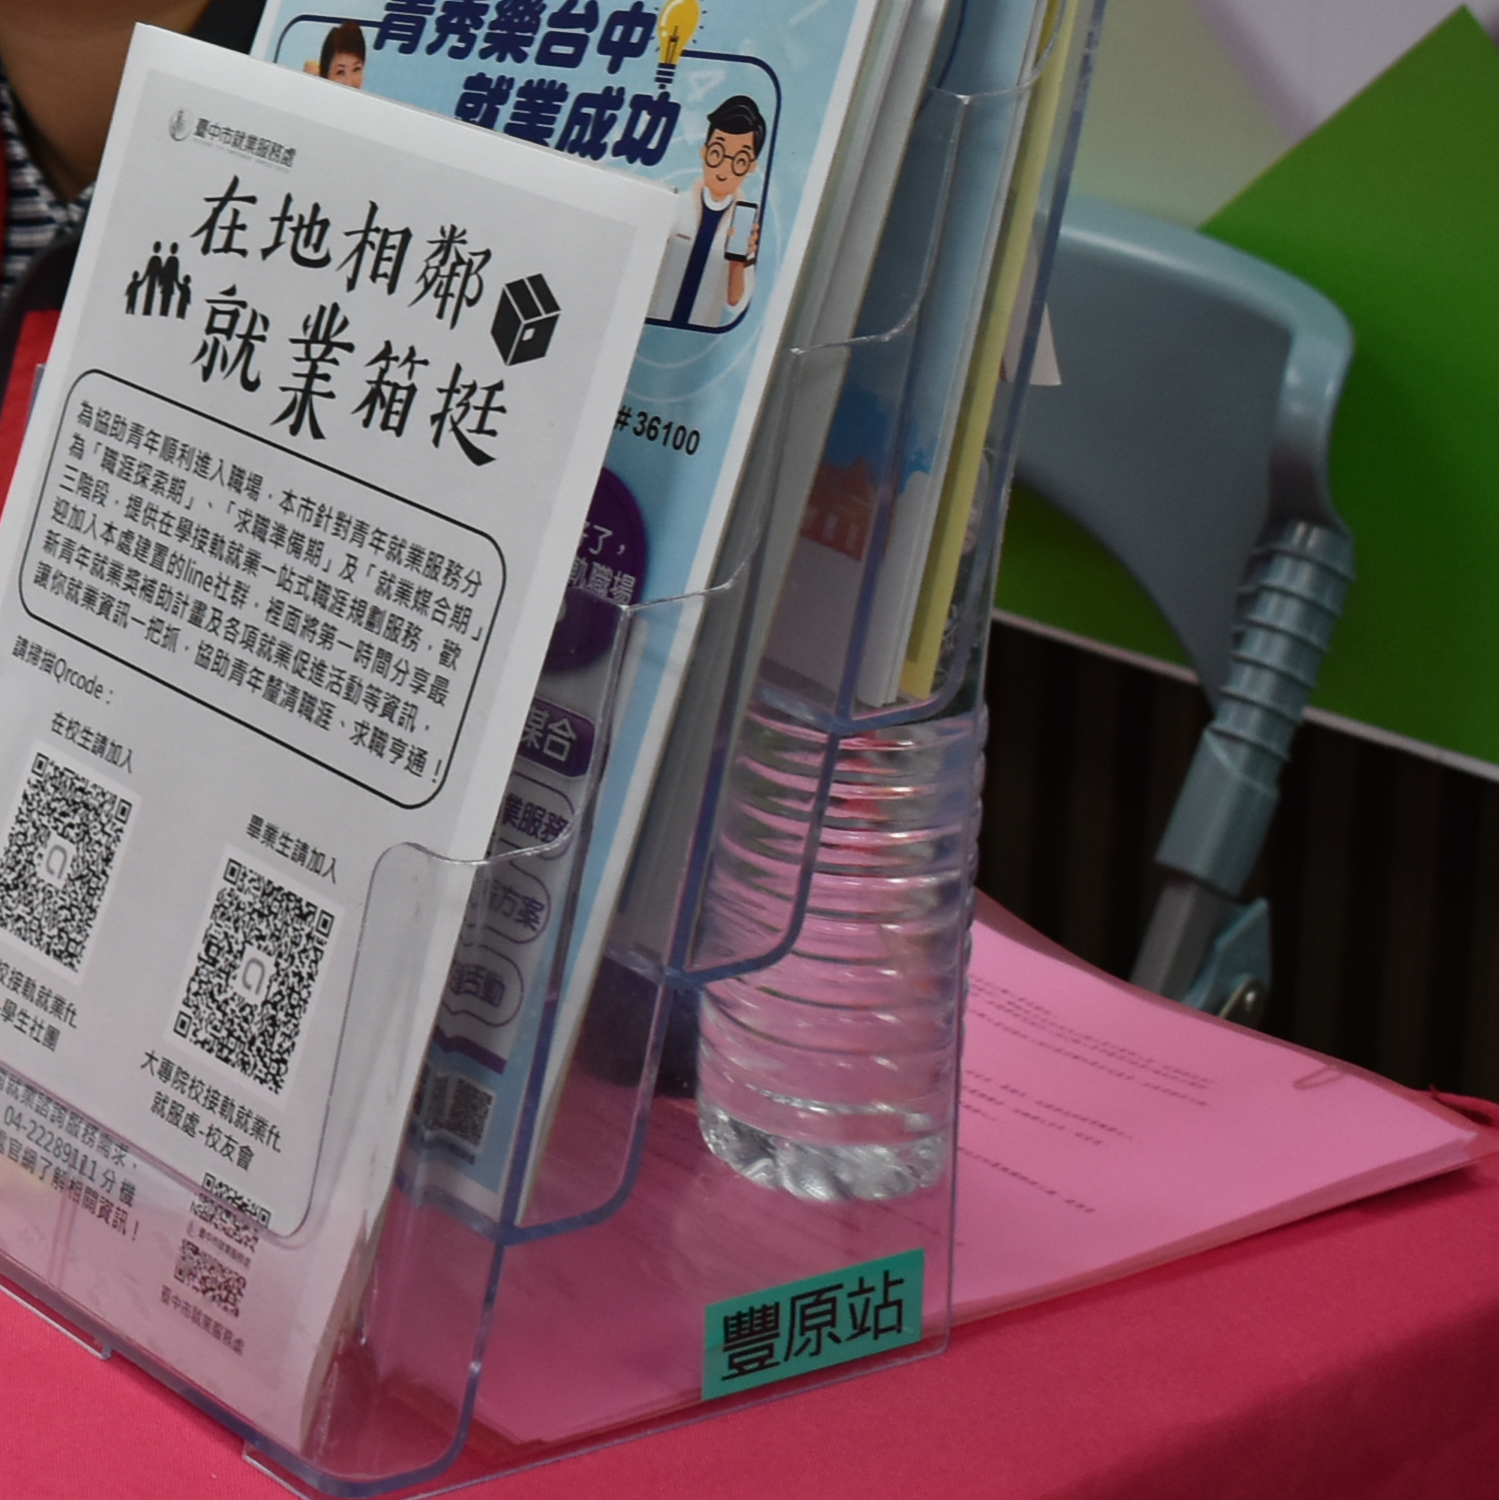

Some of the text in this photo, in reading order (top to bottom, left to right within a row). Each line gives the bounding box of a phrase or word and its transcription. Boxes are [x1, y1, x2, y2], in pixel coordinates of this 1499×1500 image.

[195, 115, 297, 169] 臺中市就業服務處
[454, 71, 683, 167] 就業成功
[189, 173, 494, 331] 在地相鄰
[189, 283, 509, 467] 就業箱挺
[614, 405, 702, 457] #36100
[51, 710, 134, 773] 在校生請加入
[245, 813, 339, 885] 畢業生請加入
[150, 1090, 254, 1171] 就服處-校友會
[720, 1269, 905, 1383] 豐原站
